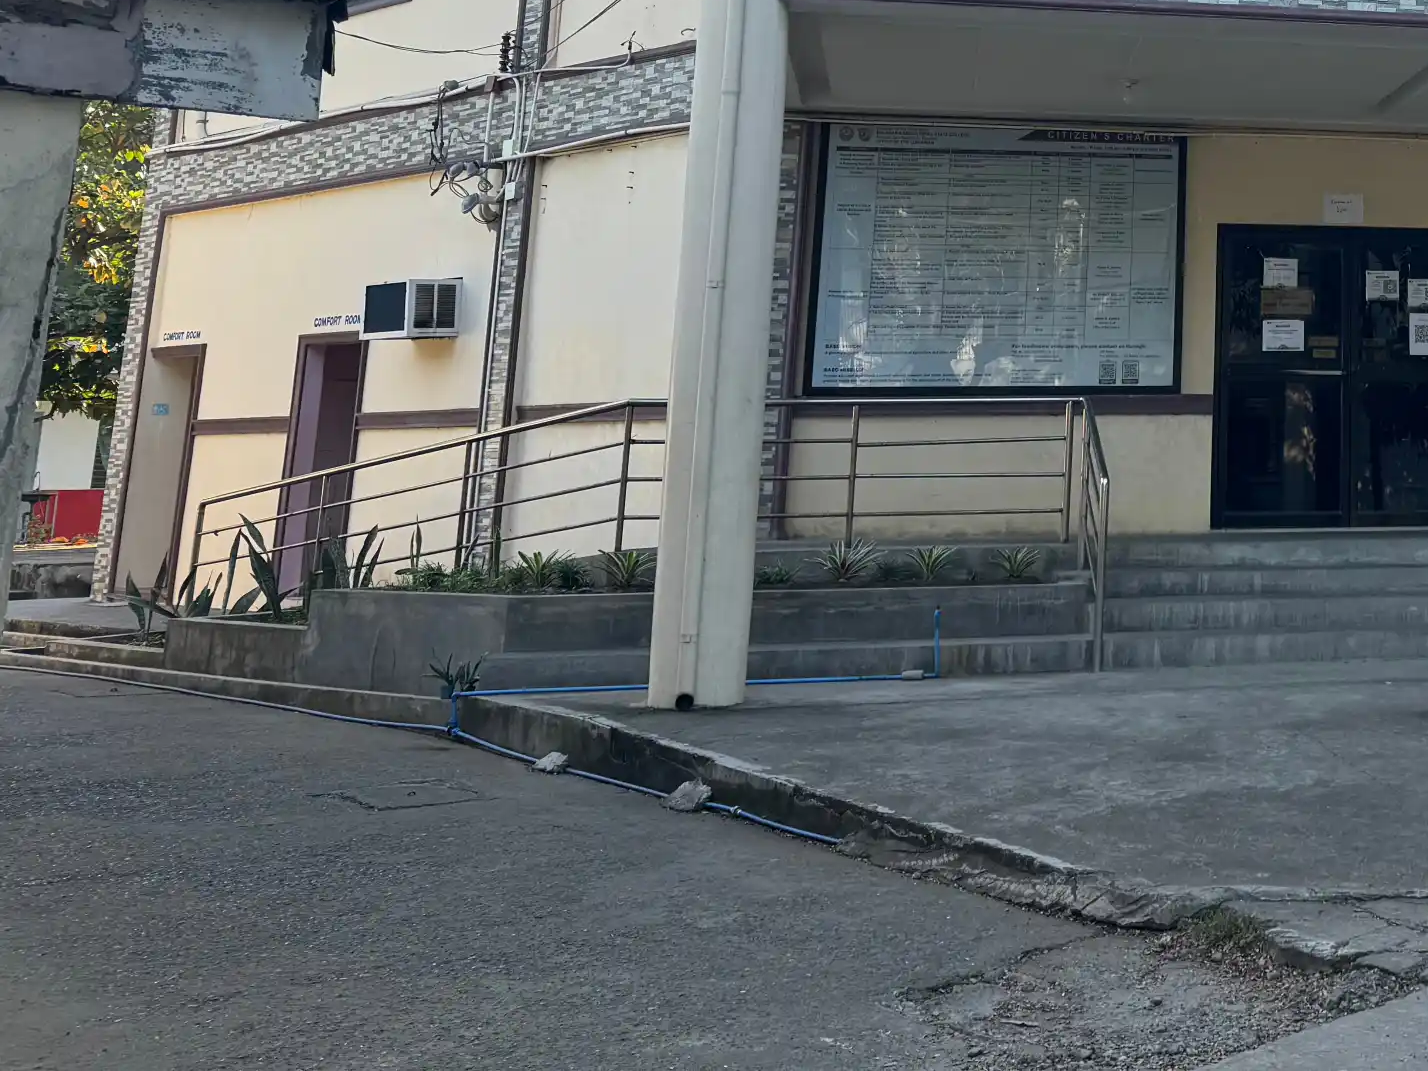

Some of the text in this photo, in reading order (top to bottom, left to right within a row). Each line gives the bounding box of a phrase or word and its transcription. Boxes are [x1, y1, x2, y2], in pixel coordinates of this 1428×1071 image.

[1117, 132, 1175, 143] CHARTER
[314, 315, 342, 327] COMFORT
[163, 331, 201, 341] COMFORT ROOM
